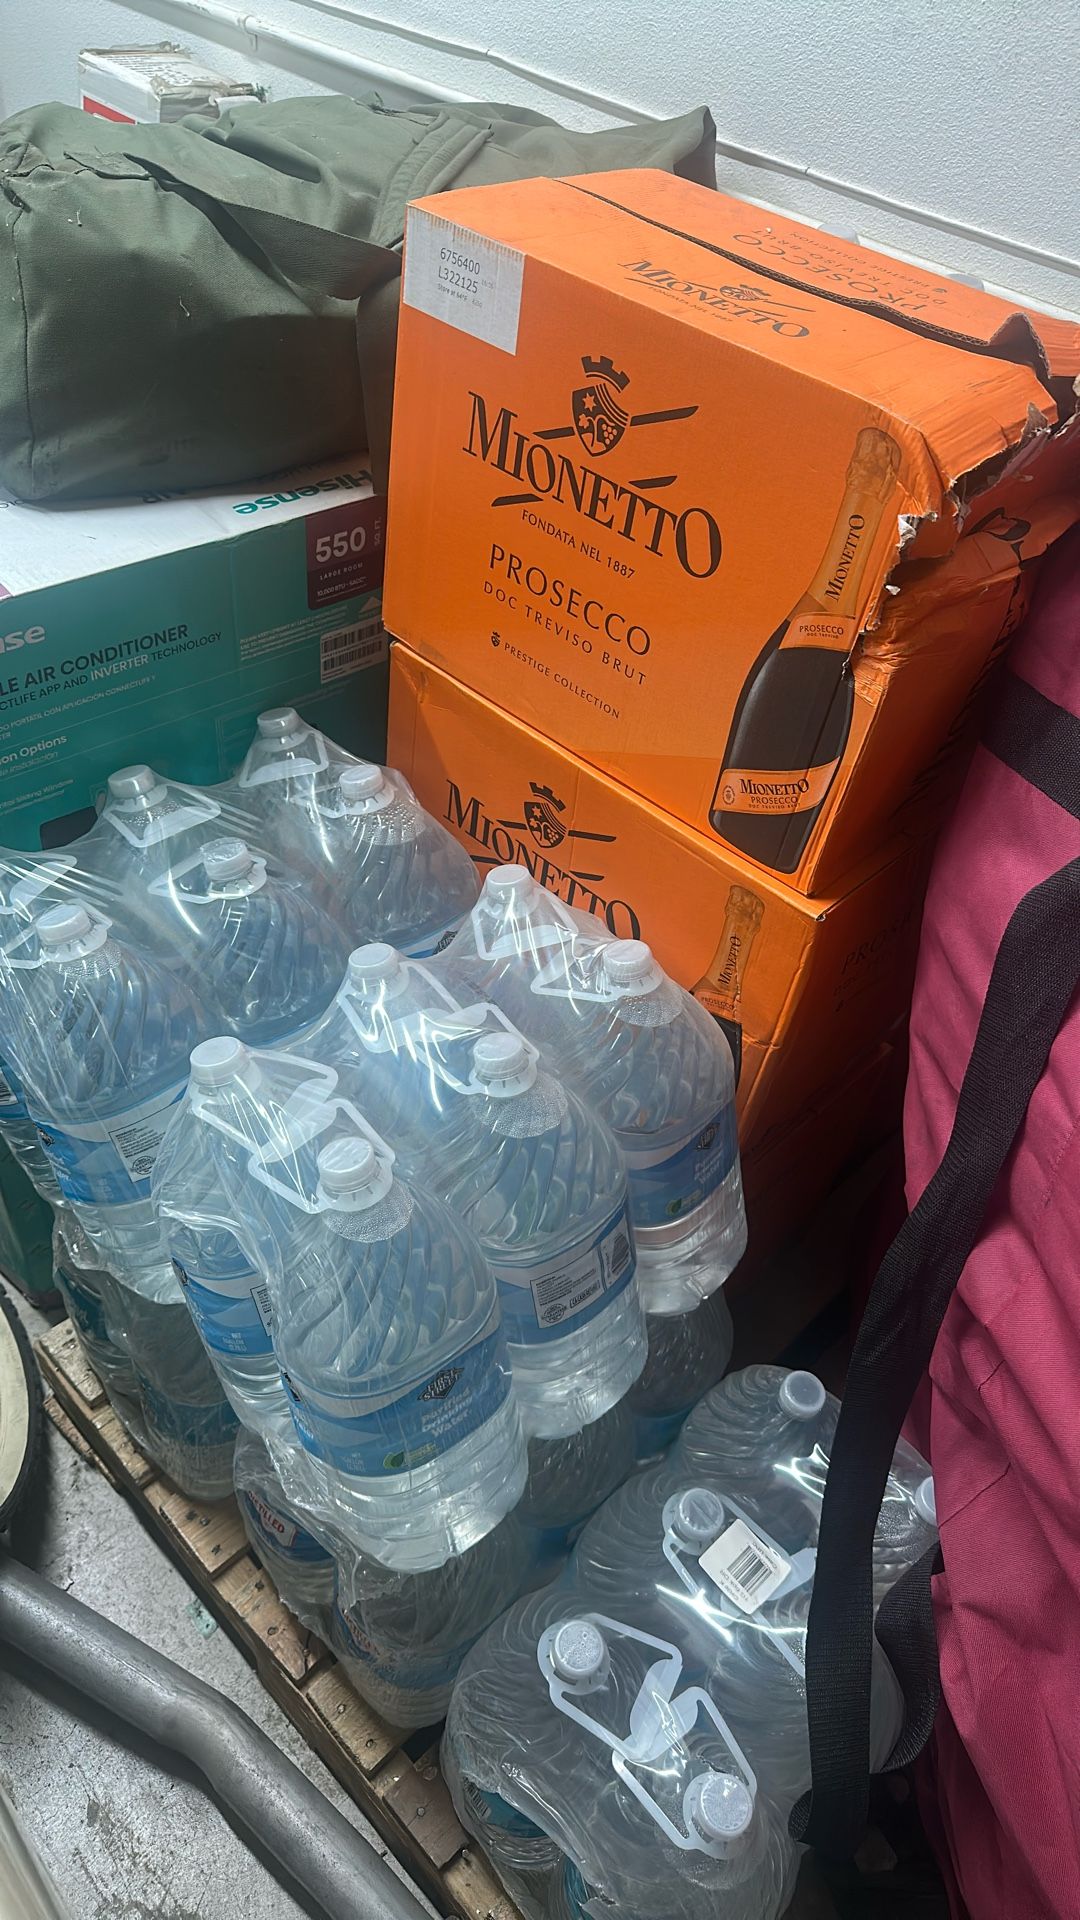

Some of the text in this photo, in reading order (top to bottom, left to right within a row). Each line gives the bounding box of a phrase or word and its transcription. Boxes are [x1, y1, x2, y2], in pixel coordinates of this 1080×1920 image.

[438, 265, 479, 294] L322125
[440, 247, 480, 275] 6756400
[733, 234, 926, 310] PROSECCO
[617, 259, 810, 338] MIONETTO
[232, 468, 374, 515] Hisense
[462, 390, 723, 579] MIONETTO
[315, 525, 367, 564] 550
[521, 509, 636, 580] FONDATA NEL 1887
[823, 513, 866, 602] MIONETTO
[484, 580, 647, 686] DOC TREVISO BRUT
[489, 543, 651, 656] PROSECCO
[799, 624, 844, 636] PROSECCO
[24, 666, 56, 689] AIR
[60, 623, 189, 676] CONDITIONER
[39, 682, 62, 699] APP
[63, 674, 88, 690] AND
[90, 653, 149, 681] INVERTER
[151, 631, 222, 662] TECHNOLOGY
[503, 642, 621, 719] PRESTIGE COLLECTION
[19, 734, 68, 758] Options
[739, 778, 810, 796] MIONETTO
[751, 796, 799, 805] PROSECCO
